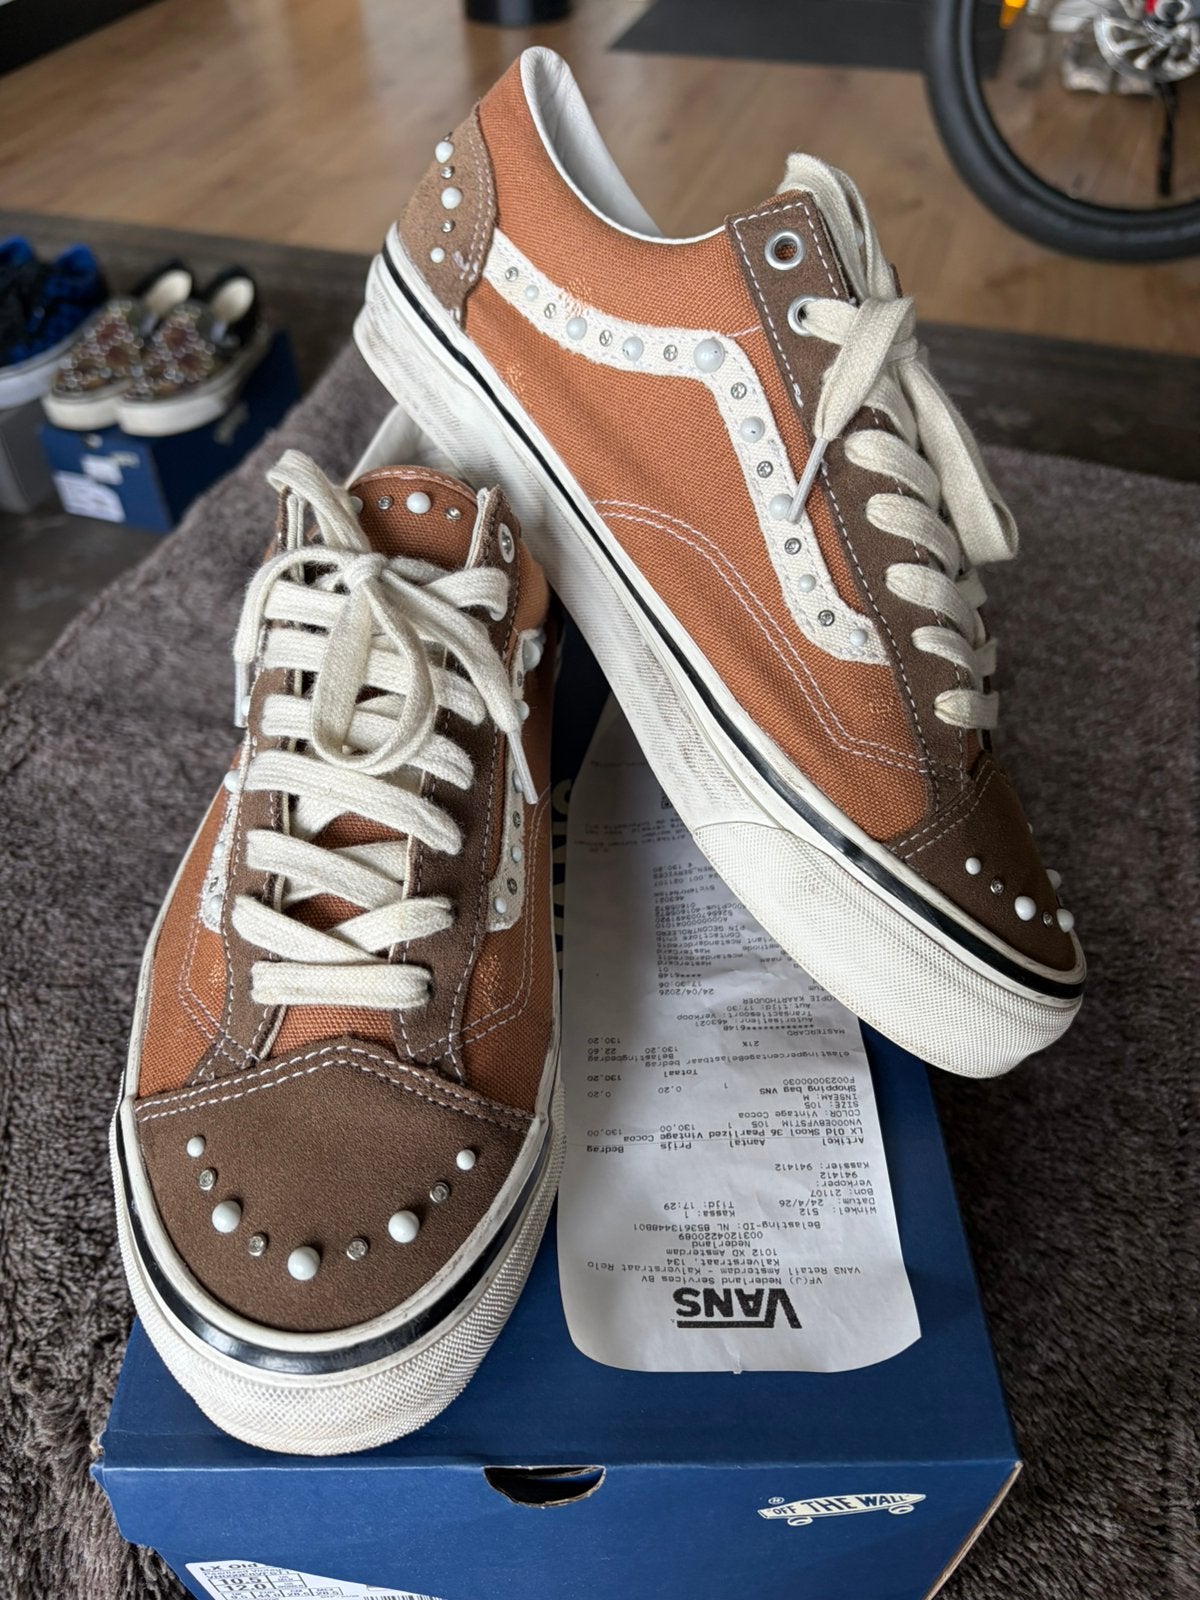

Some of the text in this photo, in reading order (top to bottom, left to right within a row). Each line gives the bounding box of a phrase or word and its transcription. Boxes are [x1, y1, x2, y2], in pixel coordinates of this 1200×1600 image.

[588, 1054, 674, 1062] Belastingbedrag
[664, 1068, 698, 1078] Totaal
[658, 1085, 682, 1094] 0,20
[808, 1084, 856, 1092] Shopping
[830, 1100, 858, 1108] SIZE:
[775, 1110, 818, 1118] Vintage
[825, 1109, 860, 1118] COLOR:
[587, 1128, 622, 1136] 130,00
[660, 1124, 695, 1132] 130,00
[790, 1128, 820, 1136] Skool
[826, 1128, 844, 1136] Old
[850, 1128, 863, 1136] LX
[624, 1134, 654, 1142] Cocoa
[660, 1132, 703, 1140] Vintage
[709, 1130, 764, 1138] Pearlized
[660, 1141, 692, 1150] Prijs
[729, 1139, 766, 1148] Aantal
[822, 1137, 864, 1146] Artikel
[586, 1146, 624, 1154] Bedrag
[775, 1162, 870, 1171] Kassier: 941412
[820, 1171, 858, 1179] 941412
[816, 1180, 872, 1188] Verkoper:
[810, 1188, 873, 1197] Bon: 21107
[664, 1200, 734, 1210] Tijd: 17:29
[779, 1197, 875, 1207] Datum: 24/4/26
[800, 1206, 876, 1216] Winkel: 512
[737, 1221, 820, 1230] Belasting-ID:
[621, 1264, 700, 1274] Kalverstraat
[662, 1276, 714, 1284] Services
[673, 1288, 802, 1329] VANS
[801, 1498, 857, 1512] THE
